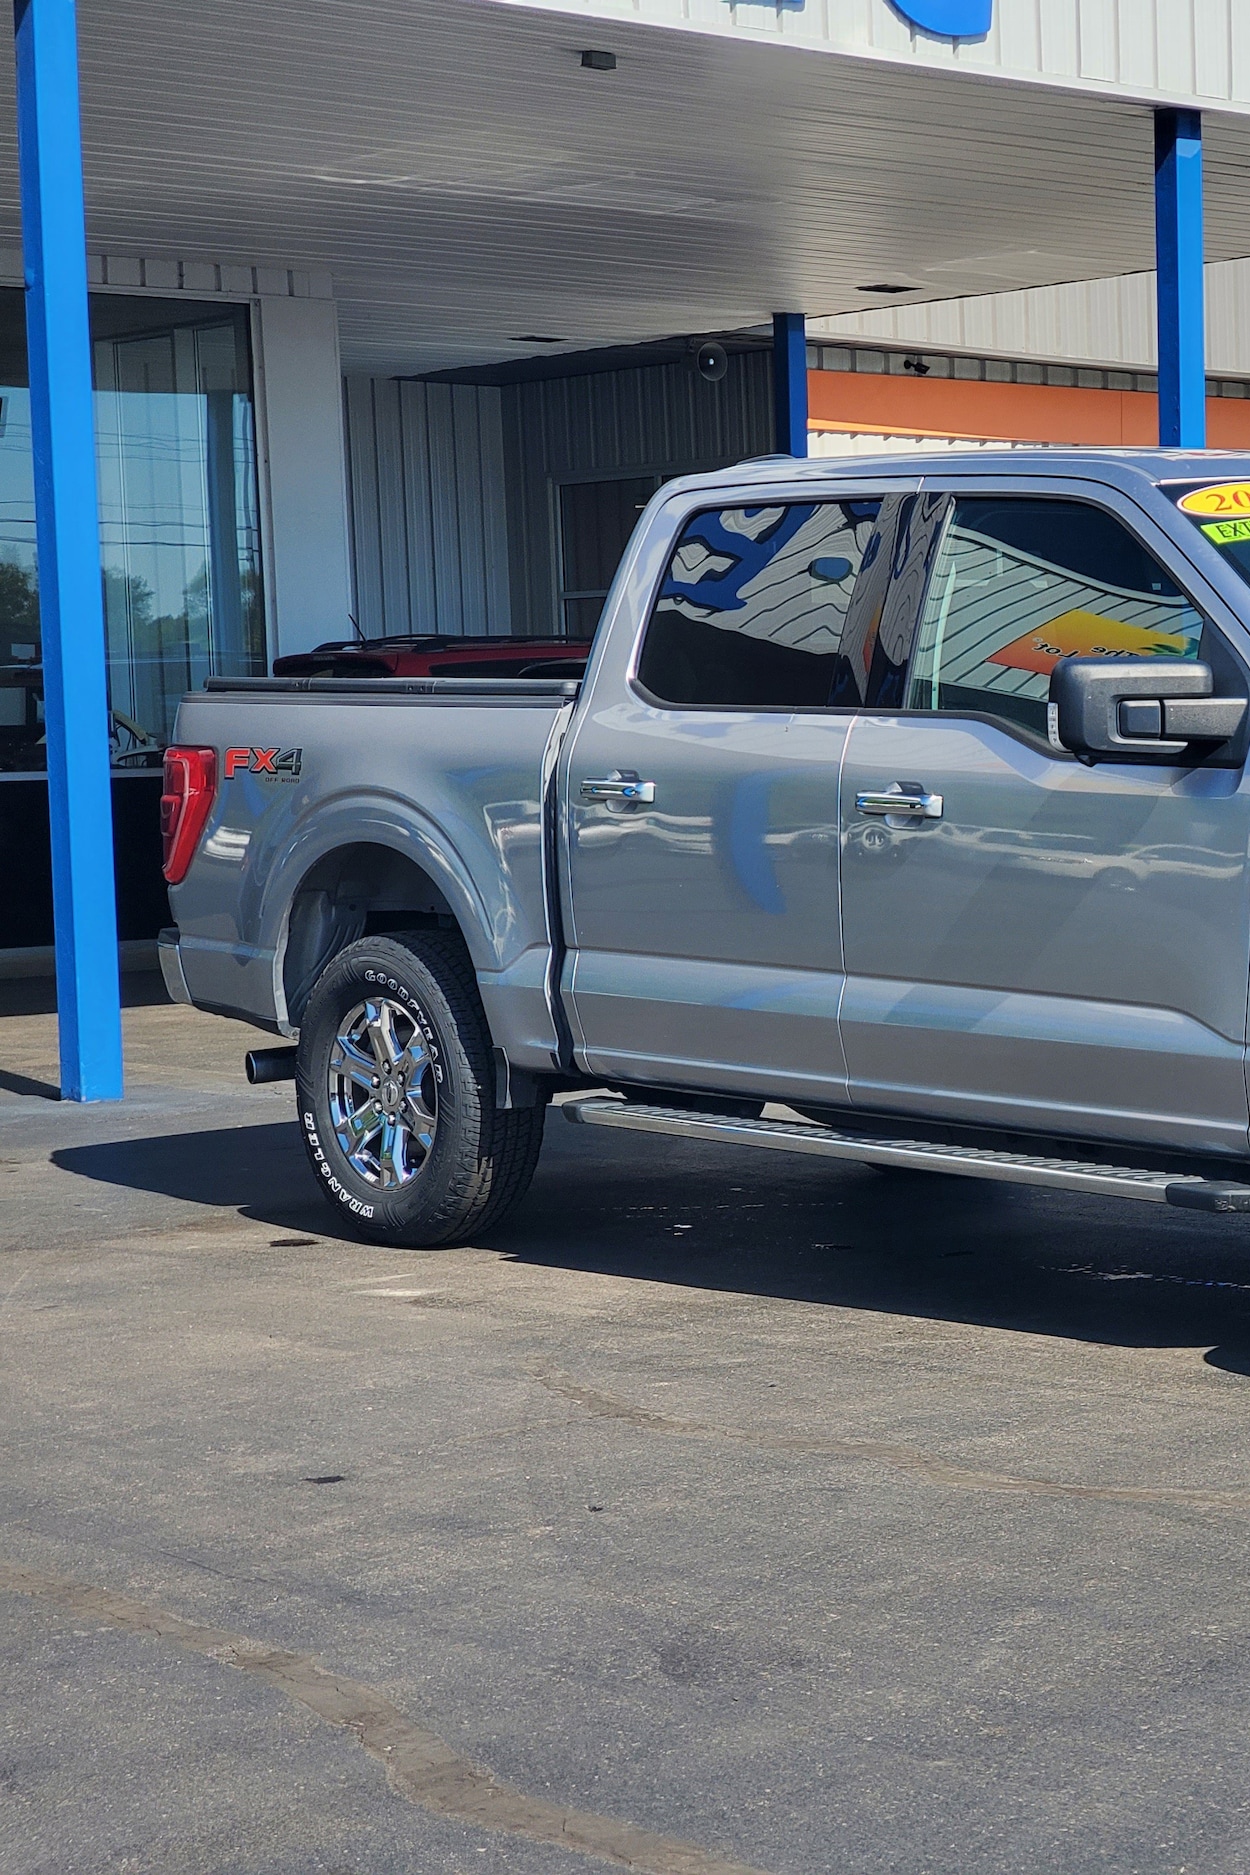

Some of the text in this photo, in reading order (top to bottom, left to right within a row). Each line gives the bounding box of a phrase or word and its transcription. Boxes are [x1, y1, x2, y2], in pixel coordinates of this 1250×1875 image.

[224, 746, 303, 780] FX4
[363, 969, 444, 1084] GOODYEAR
[303, 1111, 375, 1219] WRANGLER
